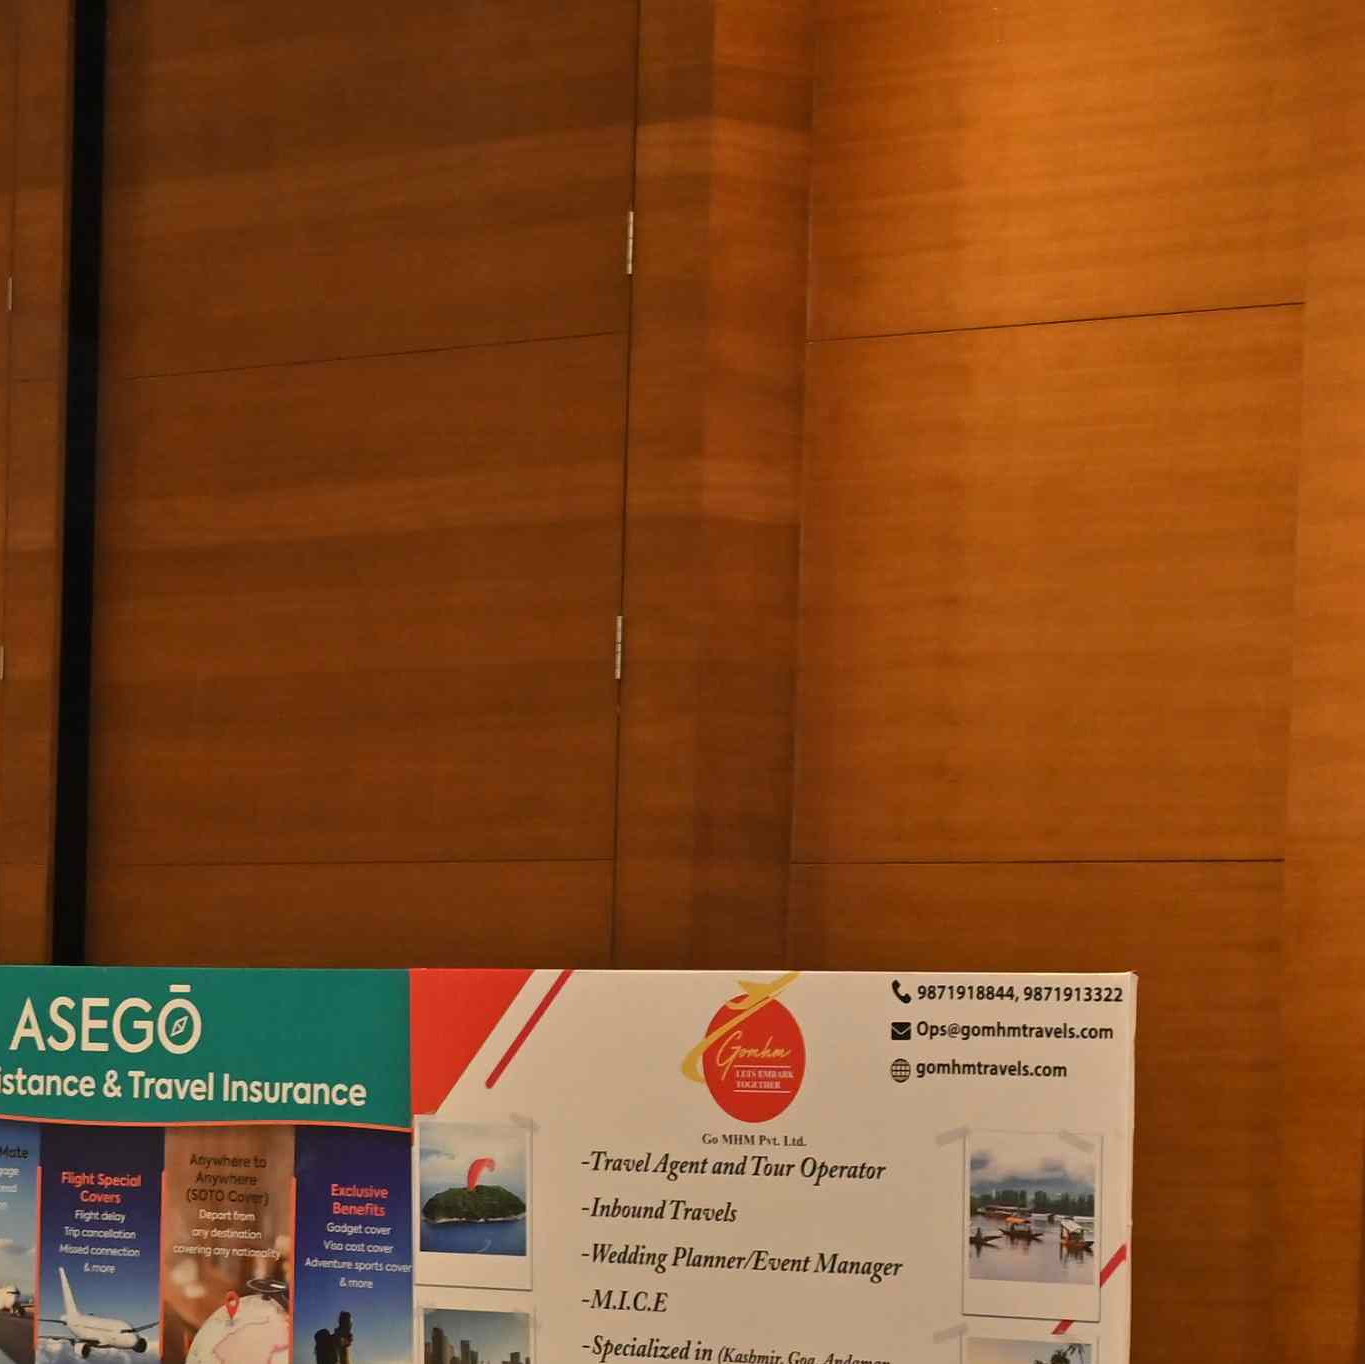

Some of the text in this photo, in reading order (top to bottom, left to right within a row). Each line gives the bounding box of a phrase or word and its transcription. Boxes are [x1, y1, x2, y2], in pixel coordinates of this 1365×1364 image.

[917, 985, 1123, 1003] 9871918844, 9871913322
[916, 1020, 1114, 1041] Ops@gomhmtravels.com
[915, 1058, 1068, 1078] gomhmtravels.com
[102, 1069, 122, 1098] &
[127, 1070, 215, 1101] Travel
[222, 1072, 367, 1107] Insurance
[736, 1080, 781, 1090] TOGETHER
[701, 1132, 808, 1148] Go MHM Pvt. Ltd.
[189, 1153, 267, 1171] Anywhere to
[581, 1150, 887, 1187] -Travel Agent and Tour Operator
[61, 1171, 142, 1188] Flight Special
[195, 1171, 258, 1188] Anywhere
[80, 1189, 122, 1204] Covers
[228, 1189, 270, 1206] Cover)
[330, 1183, 389, 1199] Exclusive
[74, 1209, 126, 1224] Flight delay
[198, 1208, 256, 1223] Depart from
[332, 1201, 386, 1217] Benefits
[581, 1196, 738, 1223] -Inbound Travels
[64, 1226, 137, 1240] Trip cancellation
[191, 1227, 262, 1240] any destination
[326, 1222, 392, 1236] Gadget cover
[59, 1243, 141, 1257] Missed connection
[172, 1245, 282, 1261] covering any nationality
[323, 1239, 394, 1254] Visa cost cover
[91, 1264, 116, 1274] more
[304, 1257, 413, 1273] Adventure sports cover
[581, 1243, 904, 1284] -Wedding Planner/Event Manager
[339, 1277, 373, 1289] & more
[581, 1288, 669, 1313] -M.I.C.E
[581, 1334, 692, 1363] -Specialized
[693, 1339, 714, 1362] in
